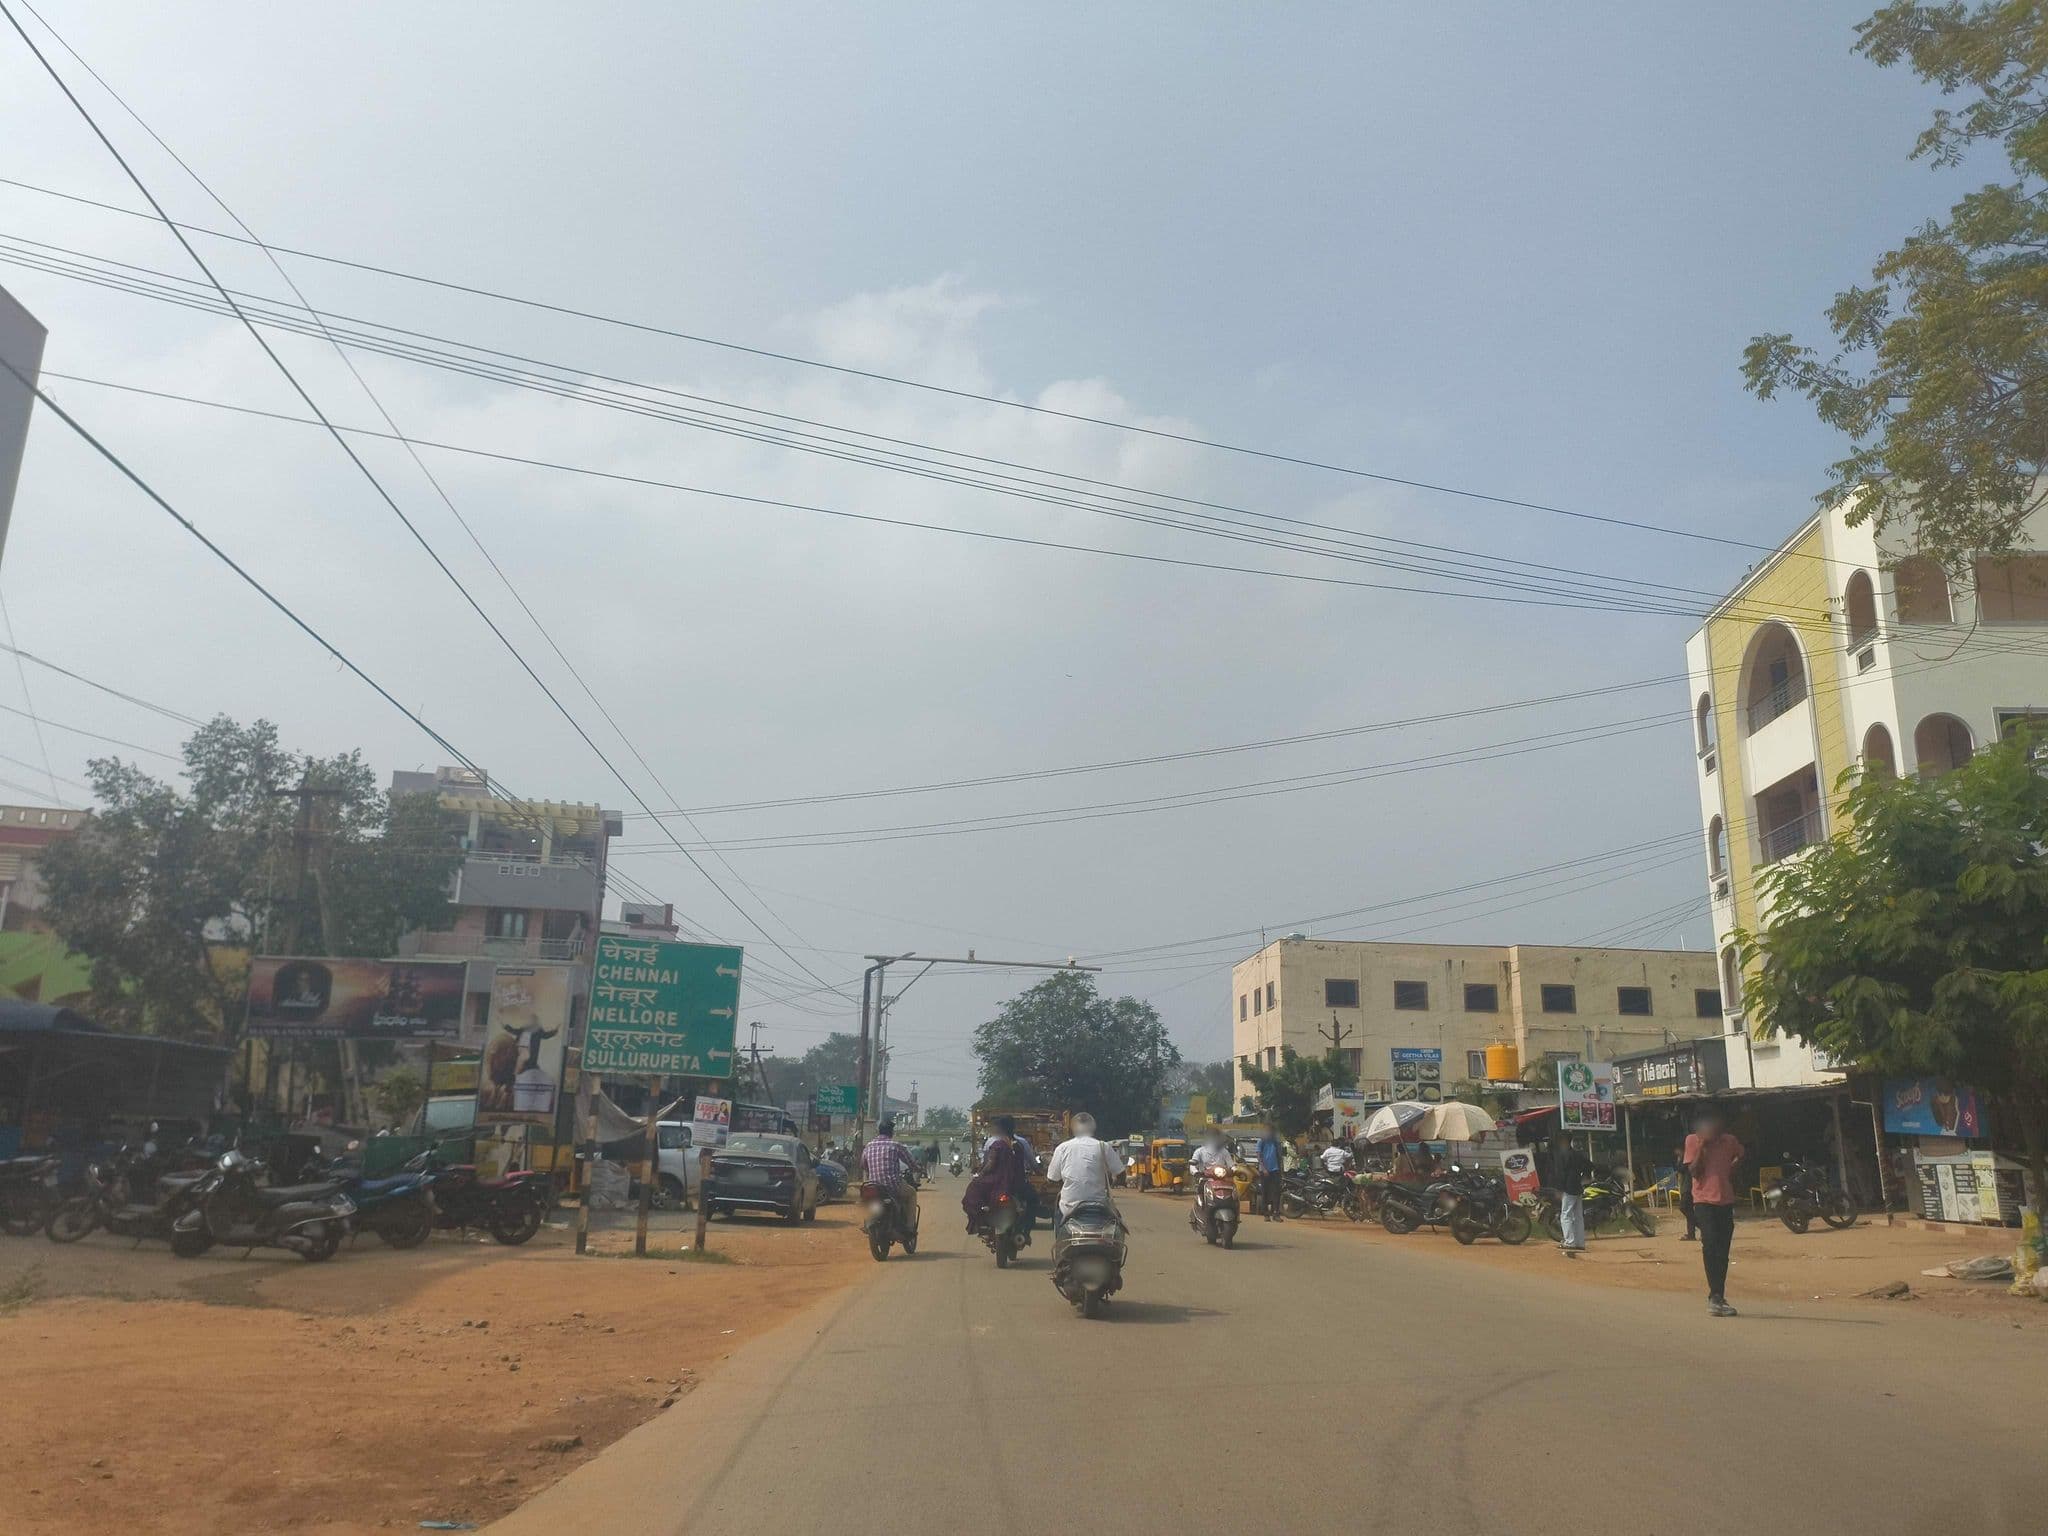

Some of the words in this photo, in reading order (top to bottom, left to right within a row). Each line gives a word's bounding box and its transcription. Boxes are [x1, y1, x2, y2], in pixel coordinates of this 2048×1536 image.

[598, 964, 679, 985] CHENNAI
[592, 1007, 678, 1026] NELLORE
[587, 1050, 700, 1071] SULLURUPETA
